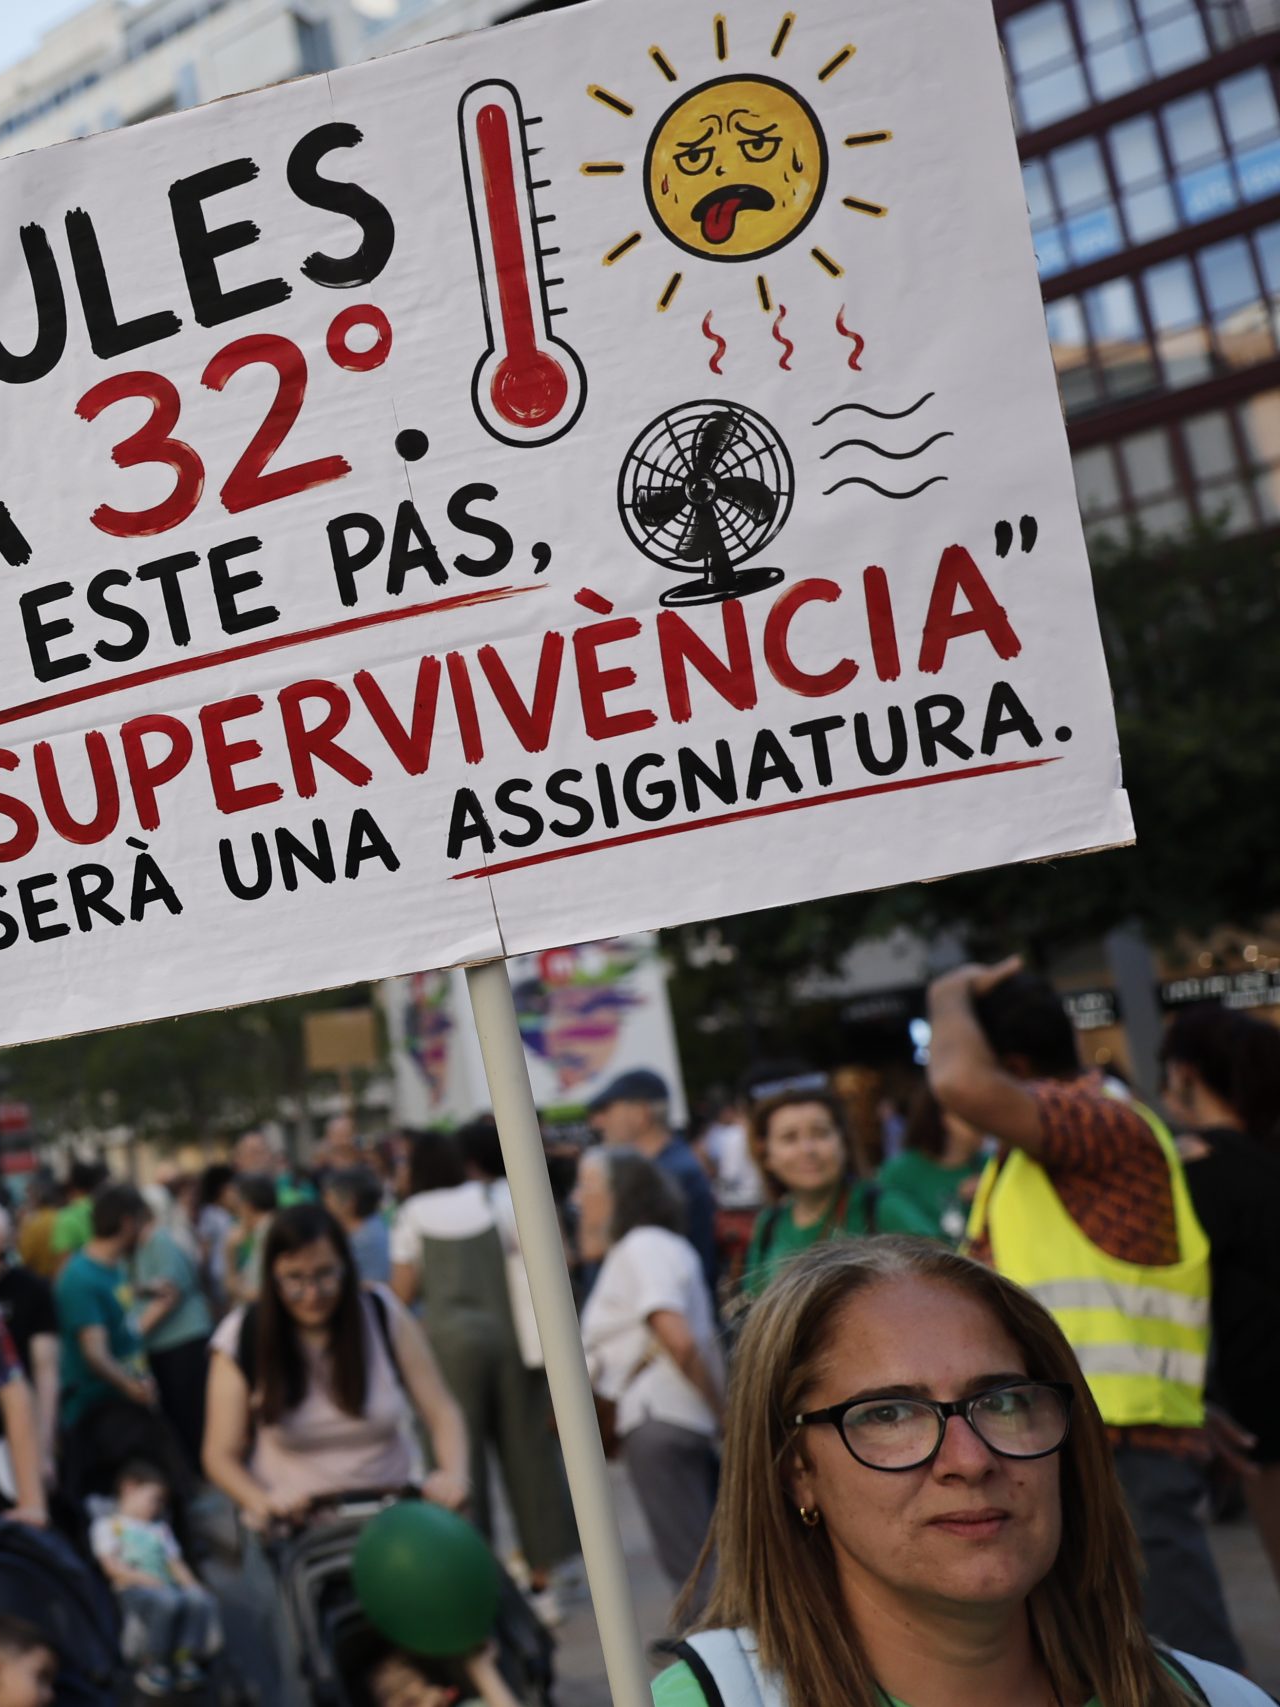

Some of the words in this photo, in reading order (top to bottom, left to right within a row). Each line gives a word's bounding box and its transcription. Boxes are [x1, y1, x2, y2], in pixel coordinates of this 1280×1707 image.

[19, 535, 282, 683] ESTE
[327, 483, 552, 607] PAS,
[219, 808, 400, 901] UNA
[447, 681, 1073, 860] ASSIGNATURA.
